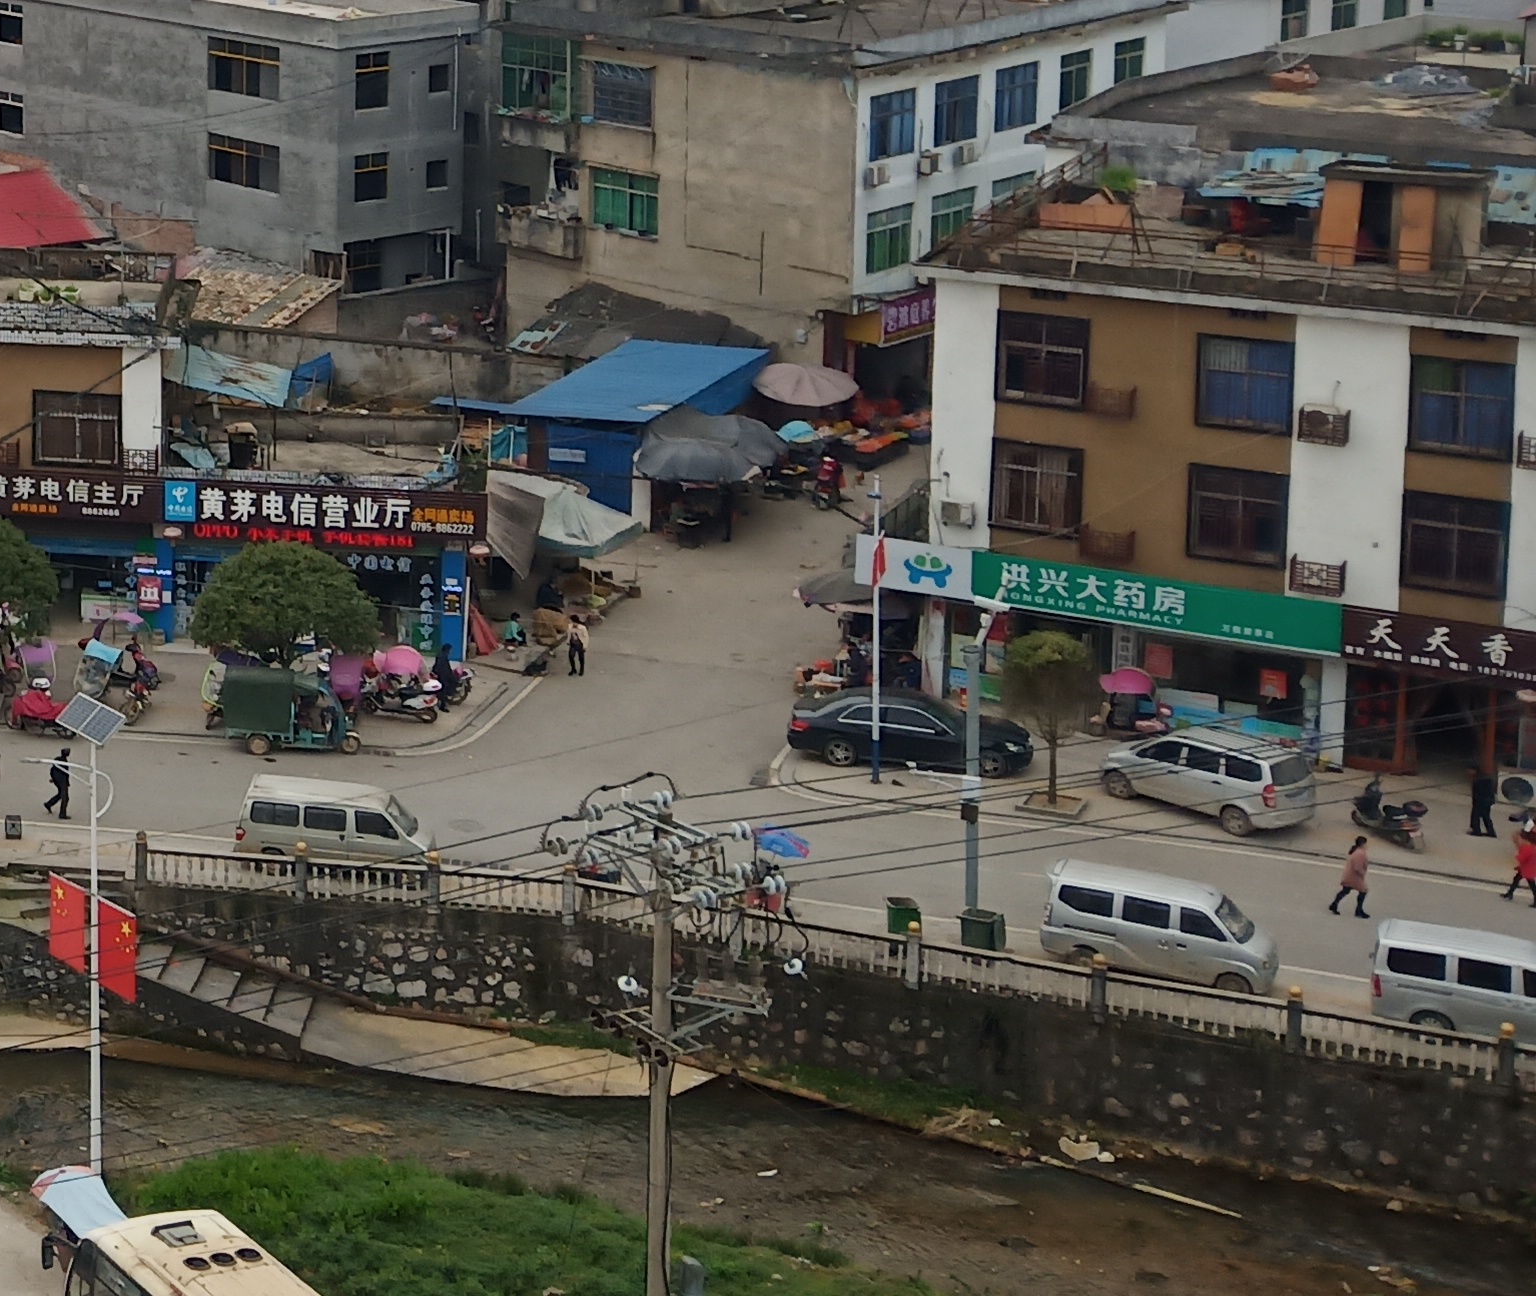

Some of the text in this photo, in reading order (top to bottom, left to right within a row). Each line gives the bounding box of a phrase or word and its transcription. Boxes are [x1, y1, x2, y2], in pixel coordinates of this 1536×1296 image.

[199, 487, 412, 529] 黄茅电信营业厅
[347, 553, 412, 573] 中国电信
[1001, 561, 1186, 616] 洪兴大药房
[1095, 605, 1184, 626] PHARMACY
[1366, 618, 1514, 667] 天天香
